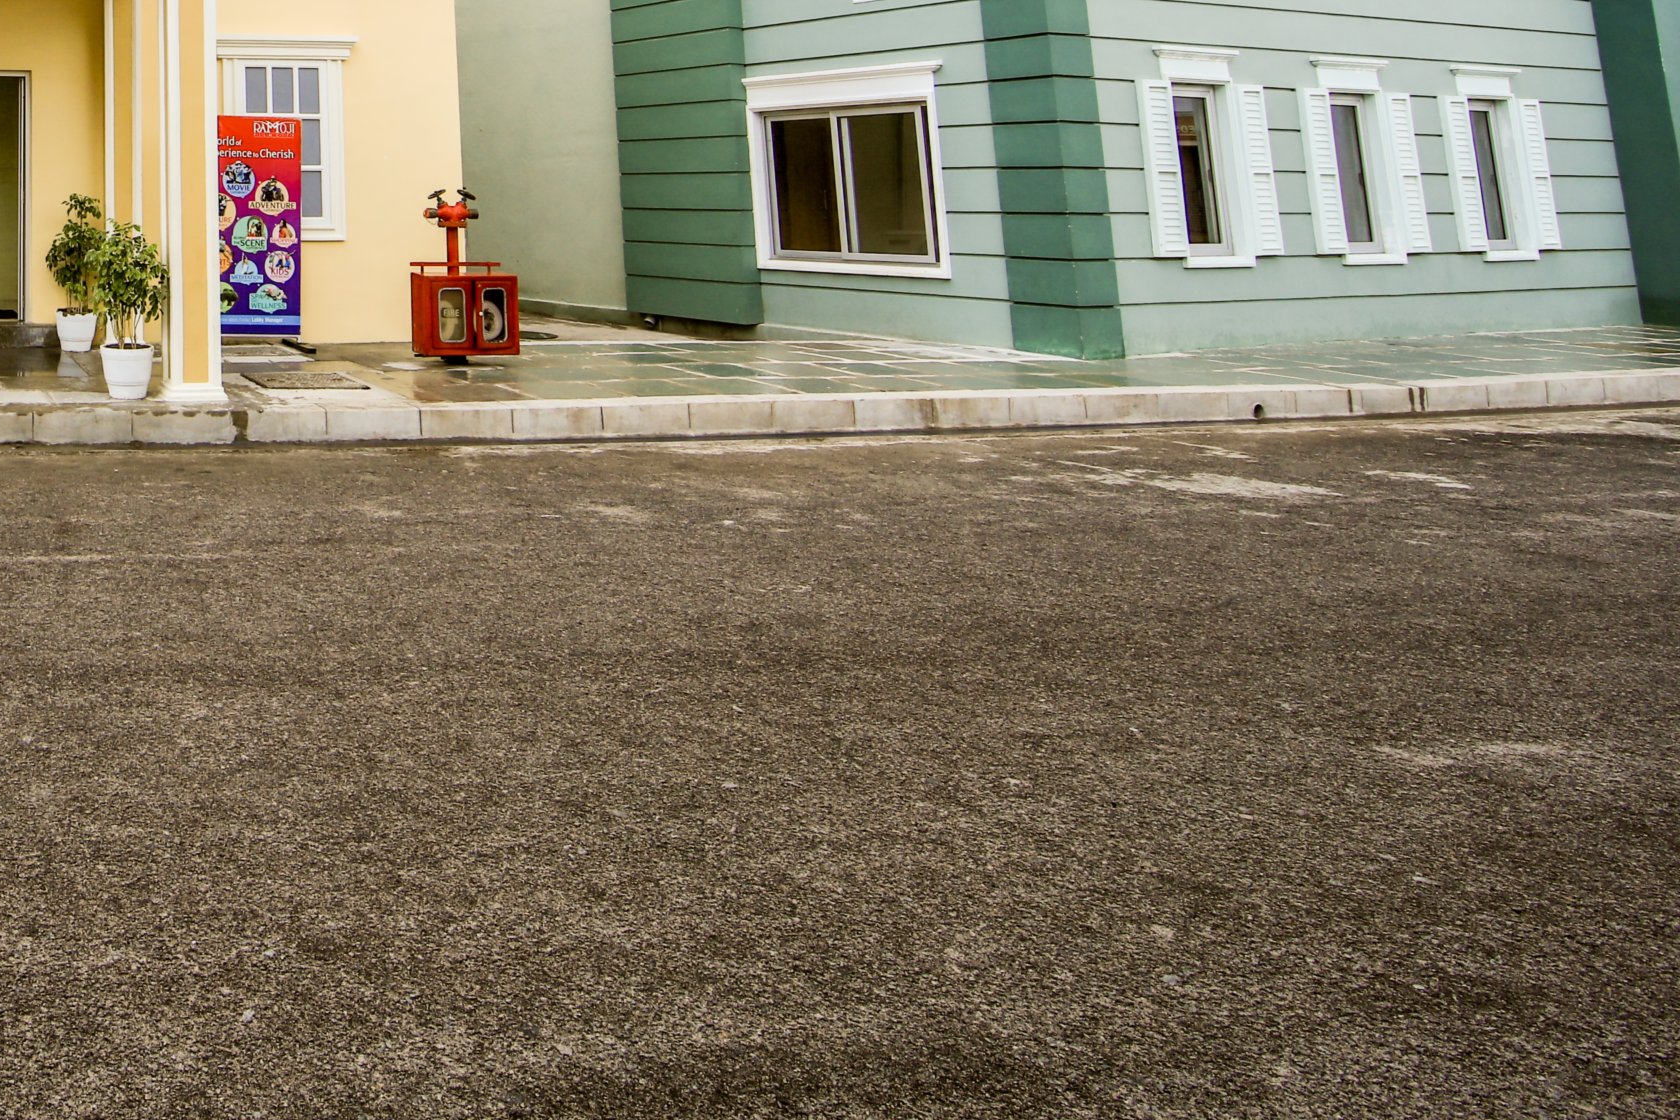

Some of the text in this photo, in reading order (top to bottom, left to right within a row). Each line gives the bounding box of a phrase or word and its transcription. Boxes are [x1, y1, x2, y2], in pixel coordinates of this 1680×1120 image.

[253, 120, 297, 134] RAMOJI
[217, 136, 235, 146] orld
[217, 148, 252, 158] erience
[260, 148, 294, 159] Cherish
[250, 201, 295, 209] ADVENTURE
[240, 239, 265, 247] SCENE
[270, 267, 289, 276] KIDS
[443, 308, 460, 317] FIRE
